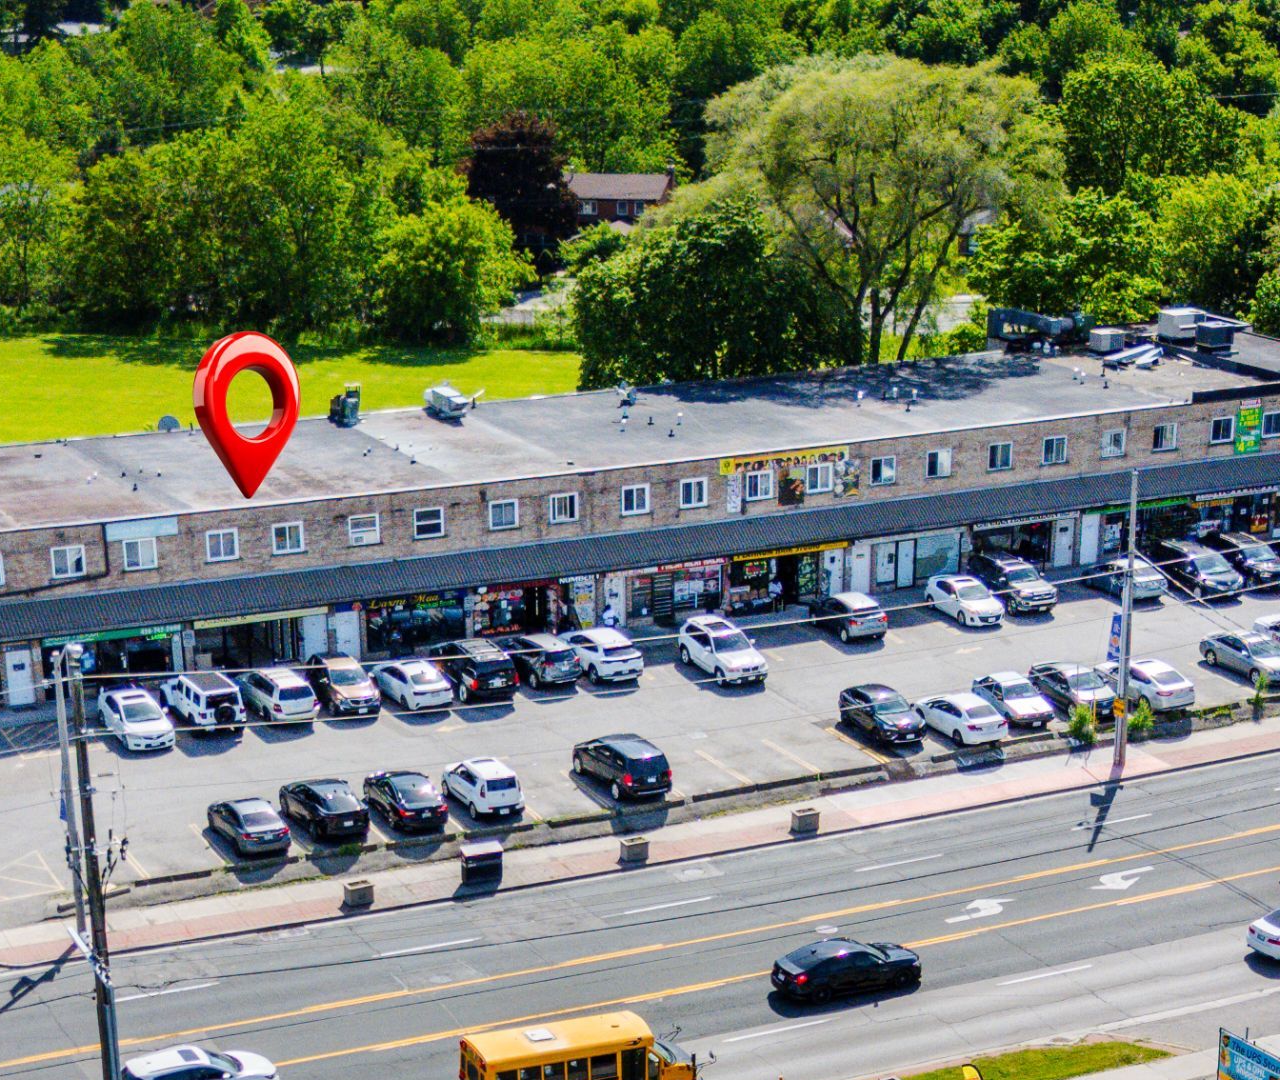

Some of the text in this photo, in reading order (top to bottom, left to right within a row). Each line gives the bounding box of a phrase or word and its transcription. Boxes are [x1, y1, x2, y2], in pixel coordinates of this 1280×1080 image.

[1232, 1040, 1246, 1054] The
[1246, 1048, 1262, 1065] UPS
[1234, 1054, 1246, 1067] UPS
